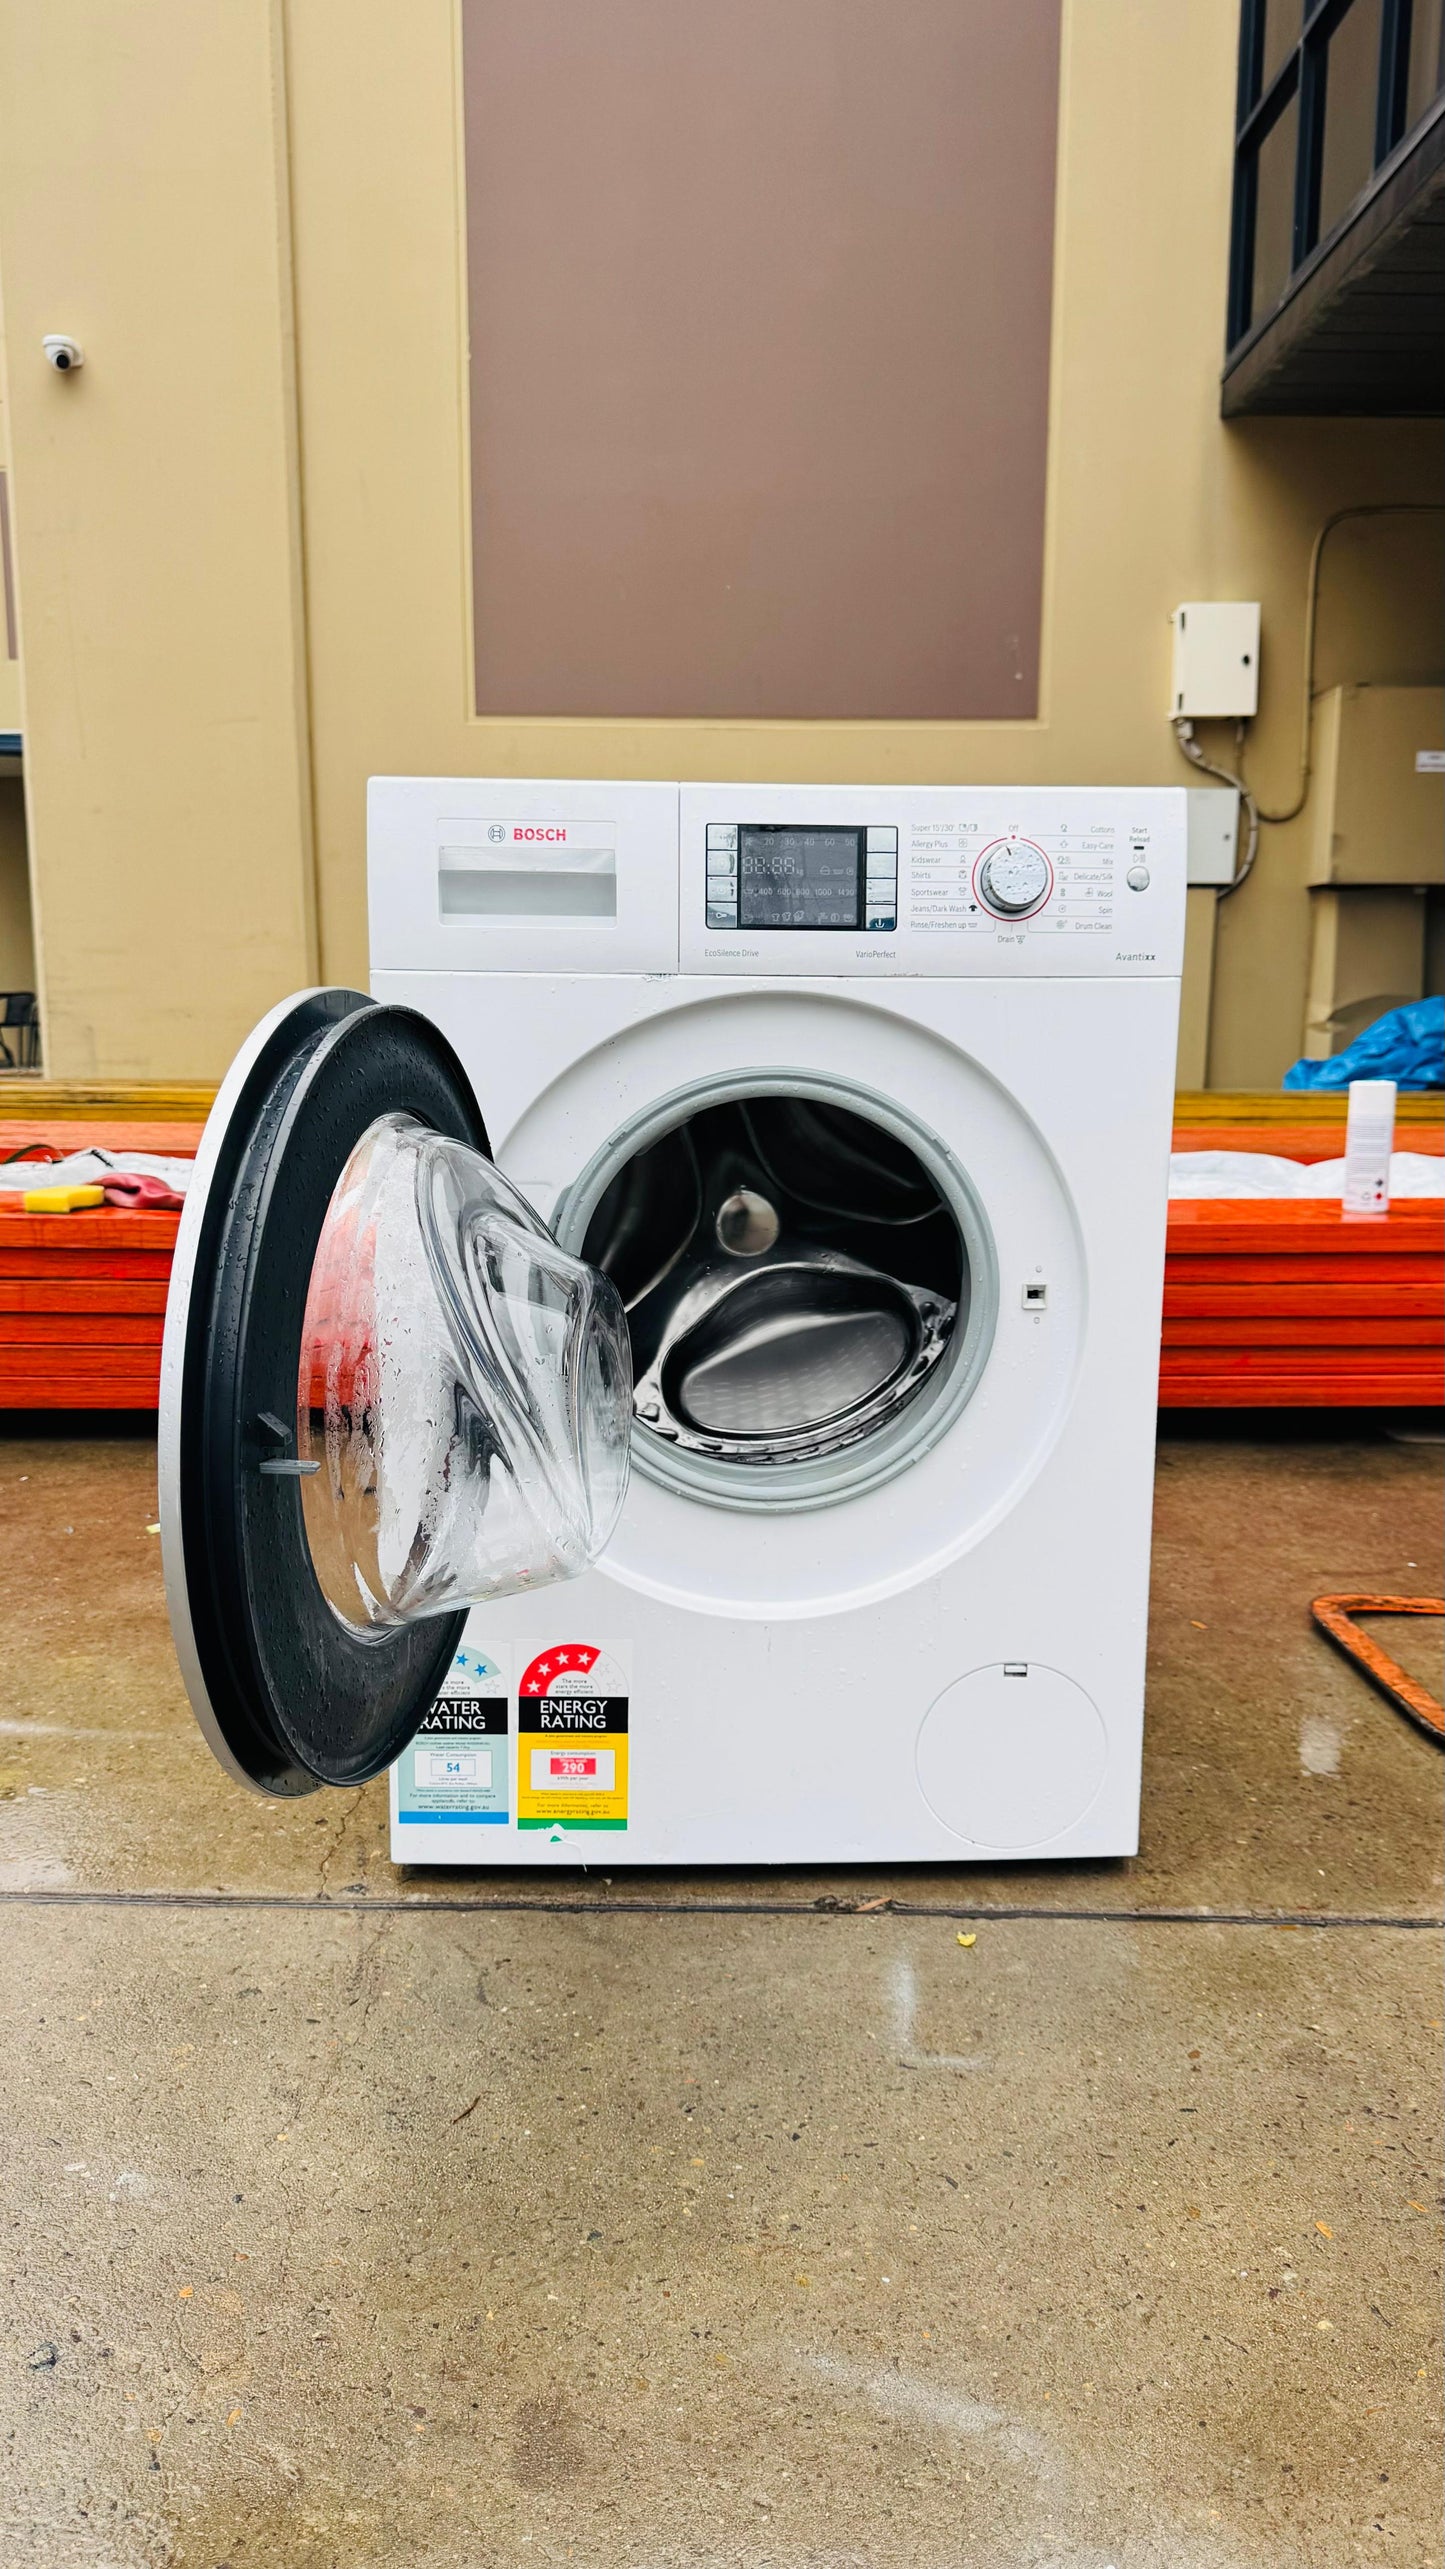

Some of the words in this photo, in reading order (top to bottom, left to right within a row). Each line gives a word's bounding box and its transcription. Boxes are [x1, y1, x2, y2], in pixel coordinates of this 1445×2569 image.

[911, 824, 931, 832] Super
[513, 828, 566, 841] BOSCH
[784, 838, 795, 846] 30
[804, 838, 815, 846] 40
[824, 838, 835, 846] 60
[911, 840, 933, 849] Allergy
[935, 840, 949, 848] Plus
[911, 856, 941, 864] Kidswear
[911, 871, 931, 879] Shirts
[911, 888, 949, 897] Sportswear
[911, 905, 947, 913] Jeans/Dark
[1098, 906, 1112, 914] Spin
[910, 921, 957, 929] Rinse/Freshen
[1075, 922, 1093, 930] Drum
[1094, 922, 1112, 930] Clean
[997, 935, 1015, 943] Drain
[704, 949, 741, 957] EcoSilence
[742, 949, 759, 957] Drive
[855, 950, 896, 959] VarioPerfect
[1115, 952, 1156, 961] Avantixx
[540, 1700, 608, 1714] ENERGY
[541, 1714, 606, 1729] RATING
[446, 1762, 460, 1772] 54
[562, 1762, 585, 1773] 290
